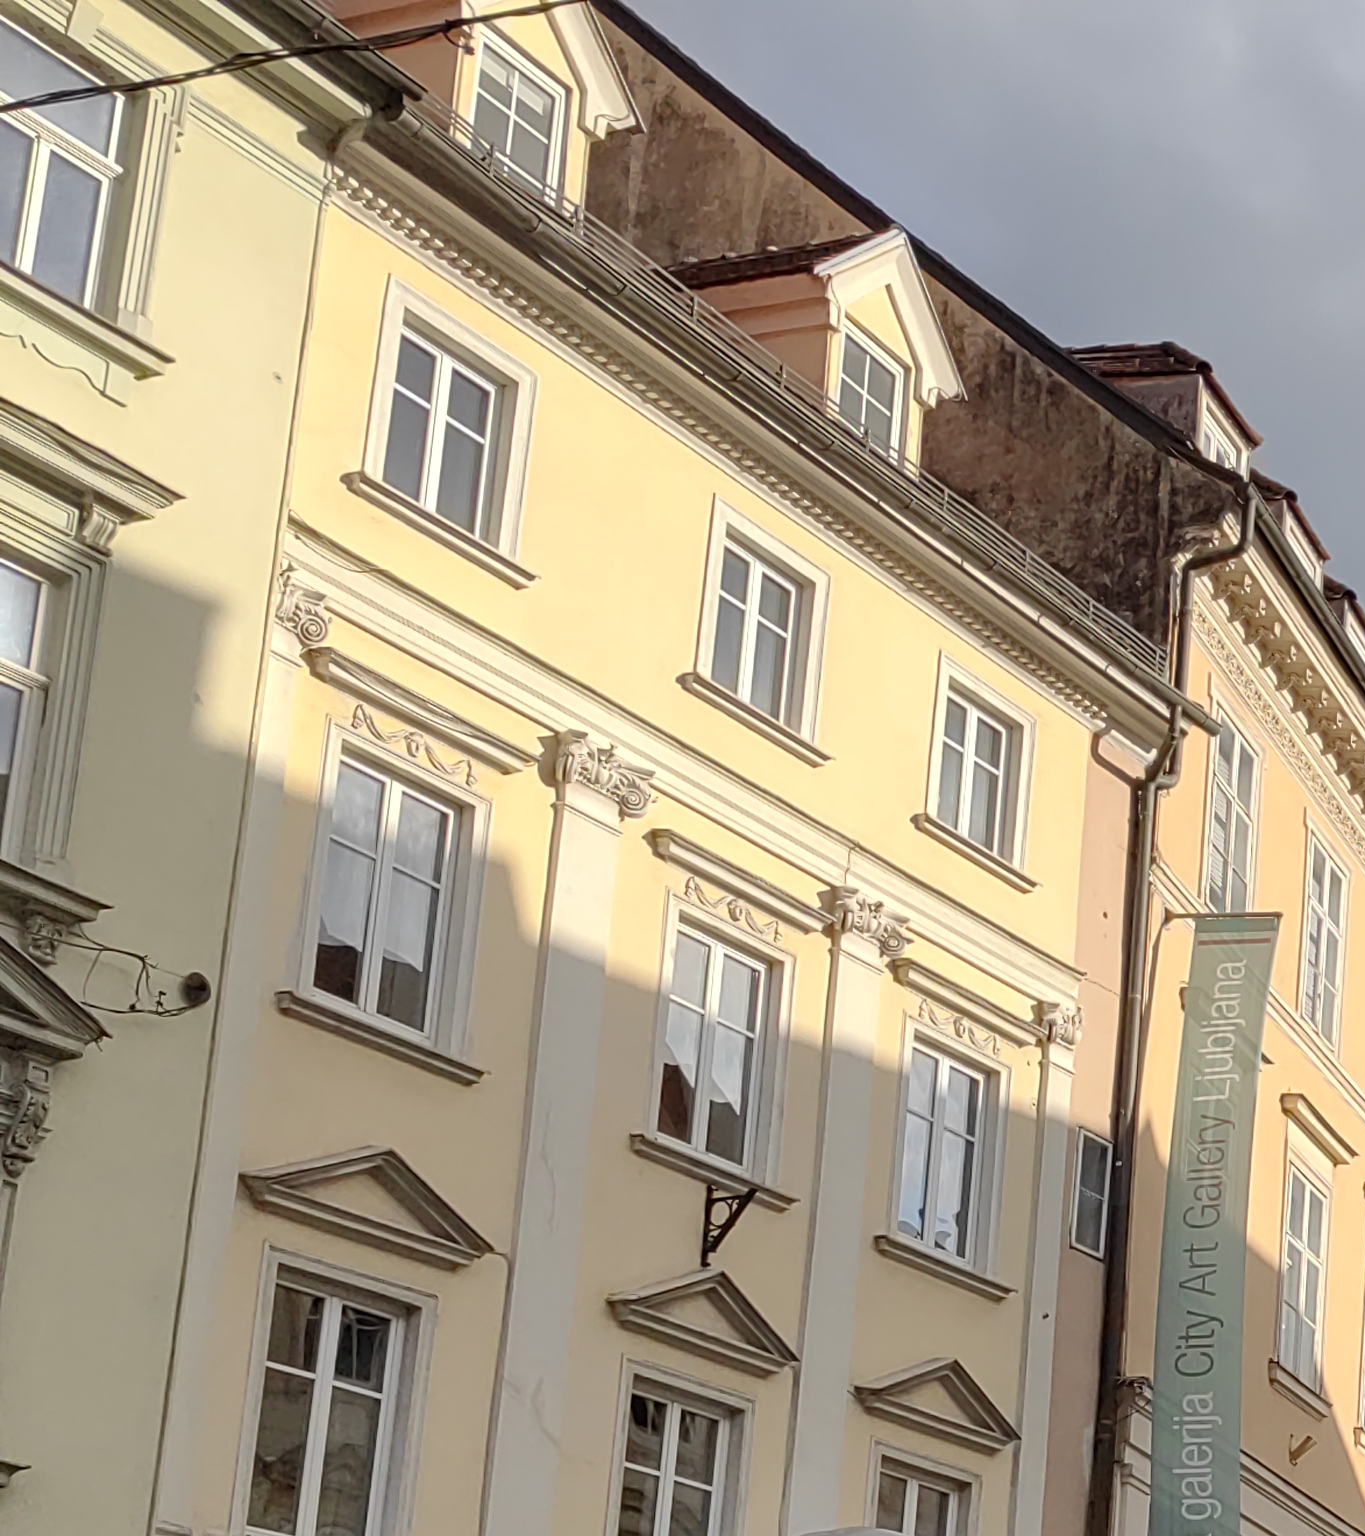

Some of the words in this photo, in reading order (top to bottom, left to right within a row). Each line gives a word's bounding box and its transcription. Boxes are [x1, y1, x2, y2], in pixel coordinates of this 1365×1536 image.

[1193, 959, 1247, 1101] Ljubljana
[1183, 1114, 1236, 1229] Gallery
[1178, 1241, 1219, 1297] Art
[1174, 1310, 1224, 1377] City
[1172, 1391, 1222, 1520] galerija
